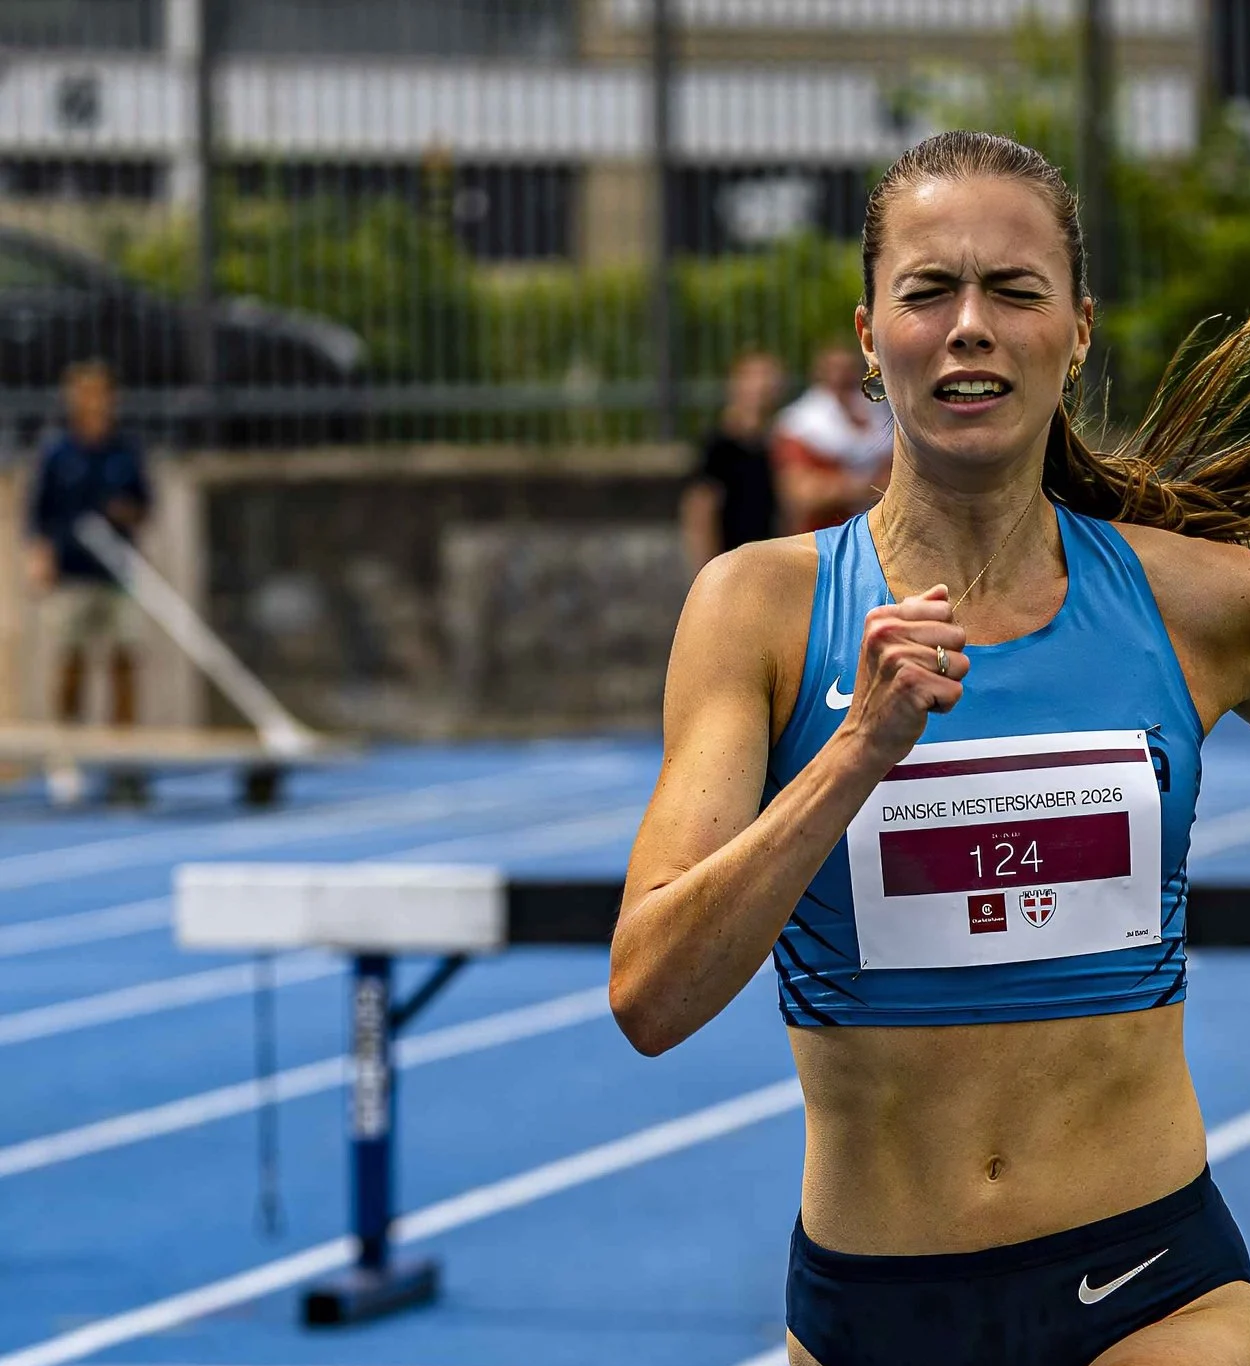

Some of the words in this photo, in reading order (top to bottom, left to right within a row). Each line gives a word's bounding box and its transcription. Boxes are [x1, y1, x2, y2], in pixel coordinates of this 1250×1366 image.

[882, 801, 947, 822] DANSKE
[951, 790, 1077, 817] MESTERSKABER
[1081, 787, 1123, 805] 2026
[969, 840, 1044, 878] 124
